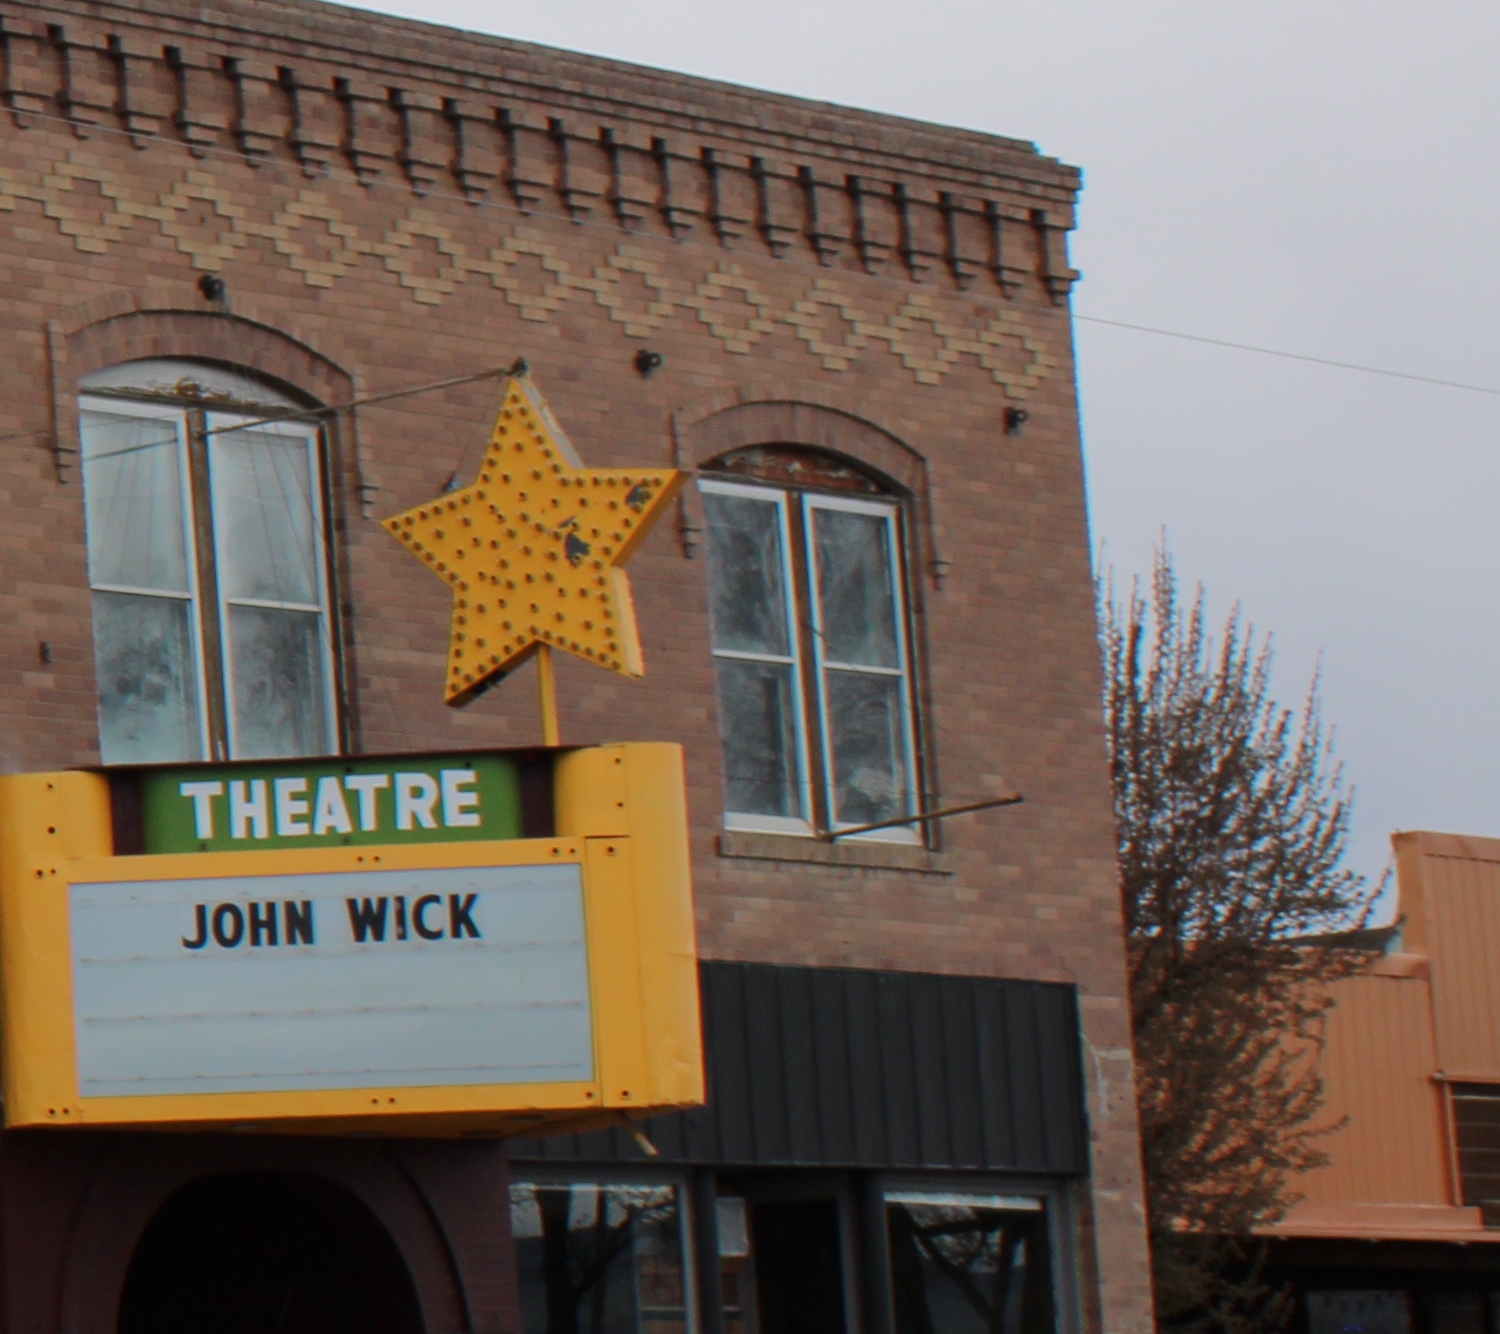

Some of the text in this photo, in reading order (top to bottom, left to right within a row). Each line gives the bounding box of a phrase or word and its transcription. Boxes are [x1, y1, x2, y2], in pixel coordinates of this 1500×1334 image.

[180, 769, 482, 840] THEATRE
[181, 893, 481, 950] JOHN WICK
